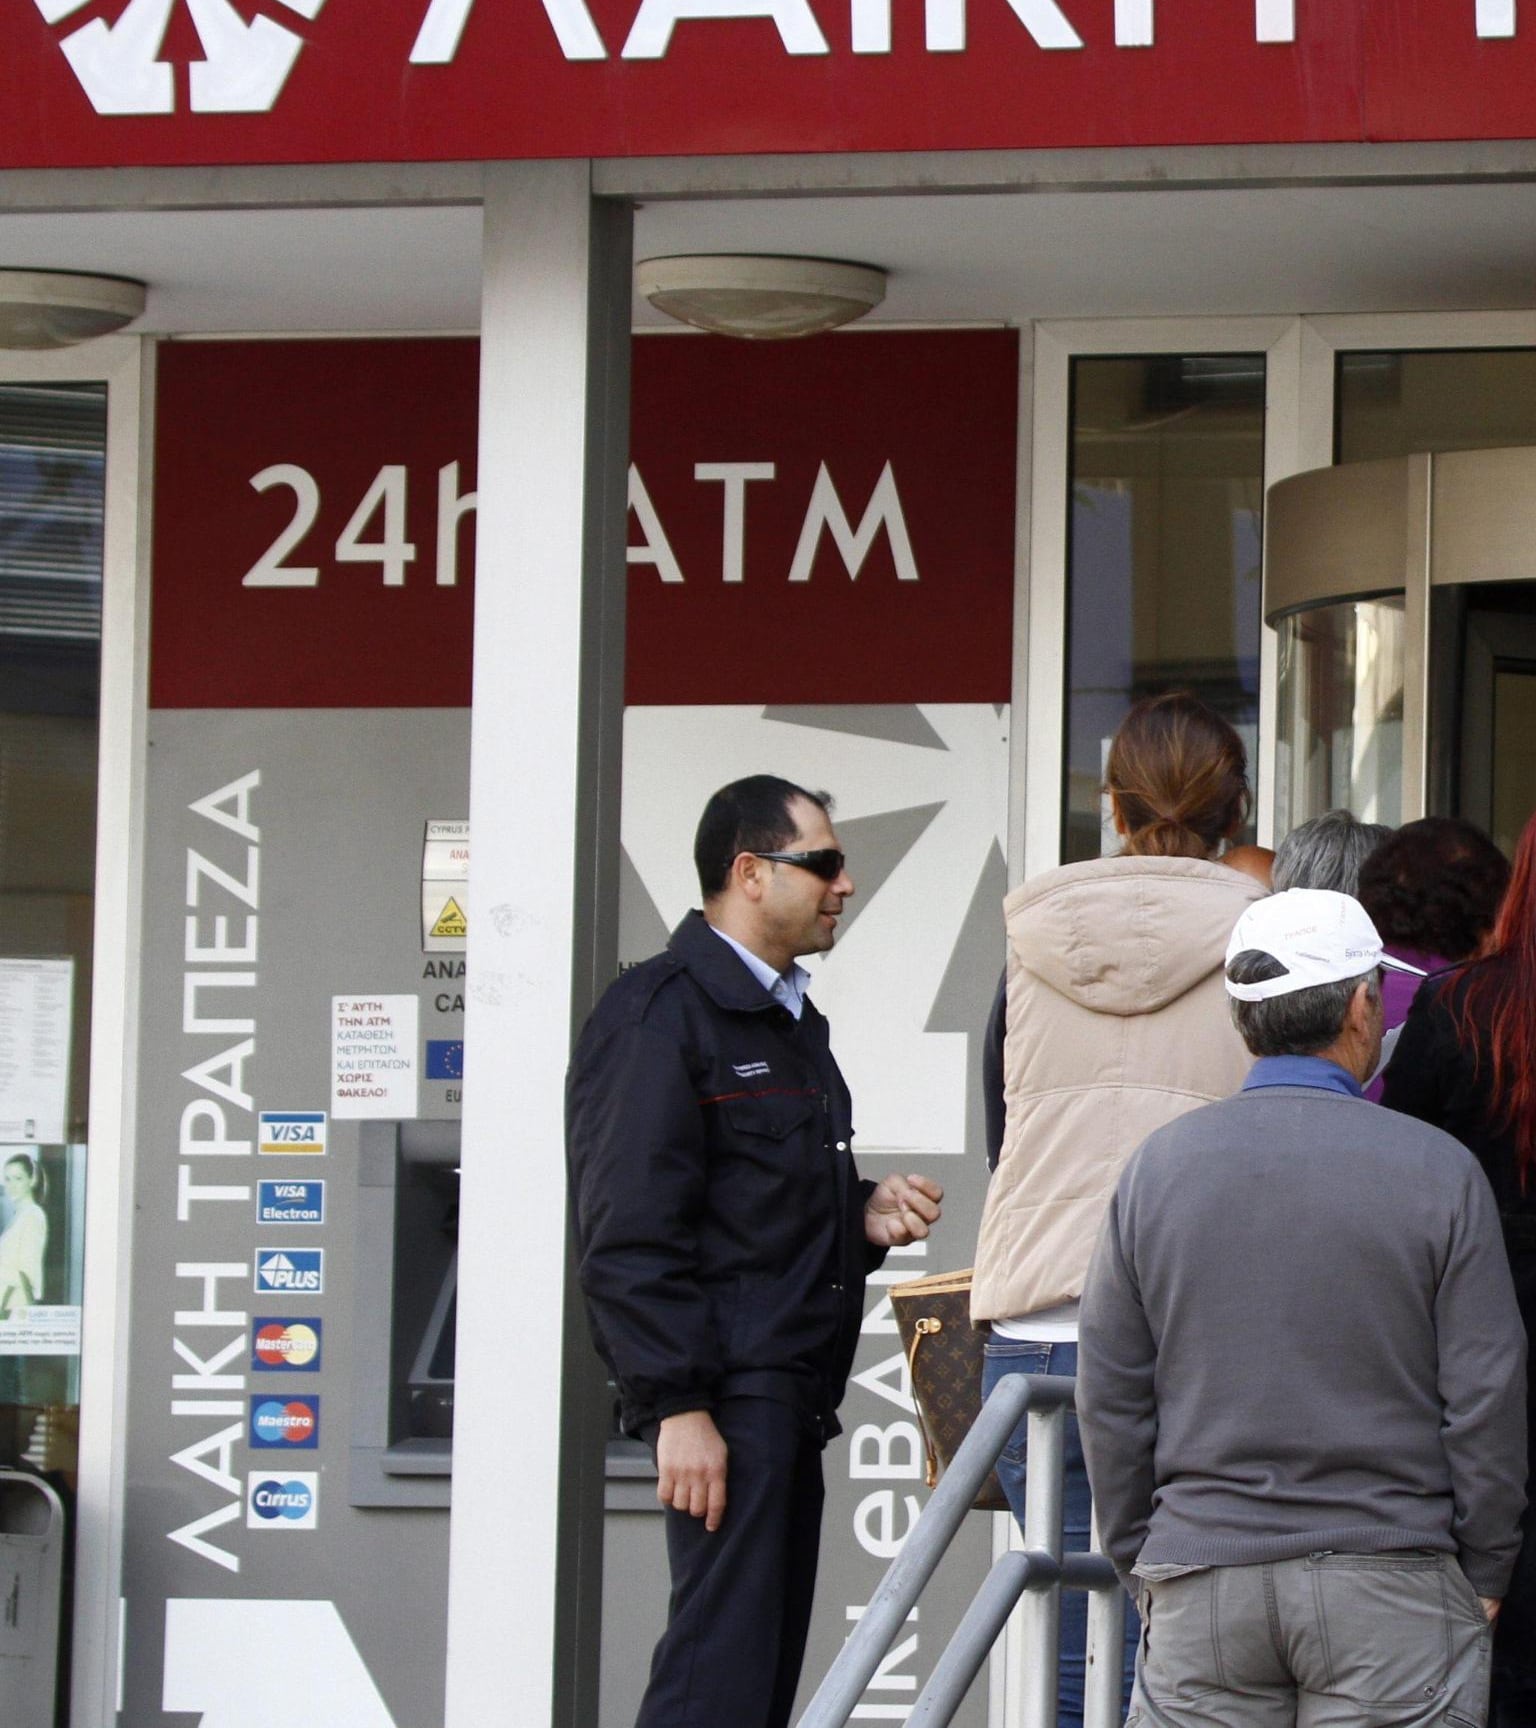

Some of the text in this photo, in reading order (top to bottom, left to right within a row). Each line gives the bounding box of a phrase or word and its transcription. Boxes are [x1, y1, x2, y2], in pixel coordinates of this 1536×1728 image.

[626, 459, 919, 582] ATM
[177, 769, 260, 1221] ΤΡΑΠΕΖΑ
[352, 1002, 383, 1012] ΑΥΤΗ
[338, 1017, 363, 1026] ΤΗΝ
[337, 1030, 393, 1040] ΚΑΤΑΘΕΣΗ
[337, 1045, 397, 1055] ΜΕΤΡΗΤΩΝ
[337, 1073, 373, 1083] ΧΩΡΙΣ
[270, 1125, 315, 1142] VISA
[274, 1186, 307, 1198] VISA
[263, 1208, 319, 1220] Electron
[274, 1271, 320, 1288] PLUS
[257, 1415, 312, 1427] Maestro
[256, 1490, 308, 1507] Cirrus
